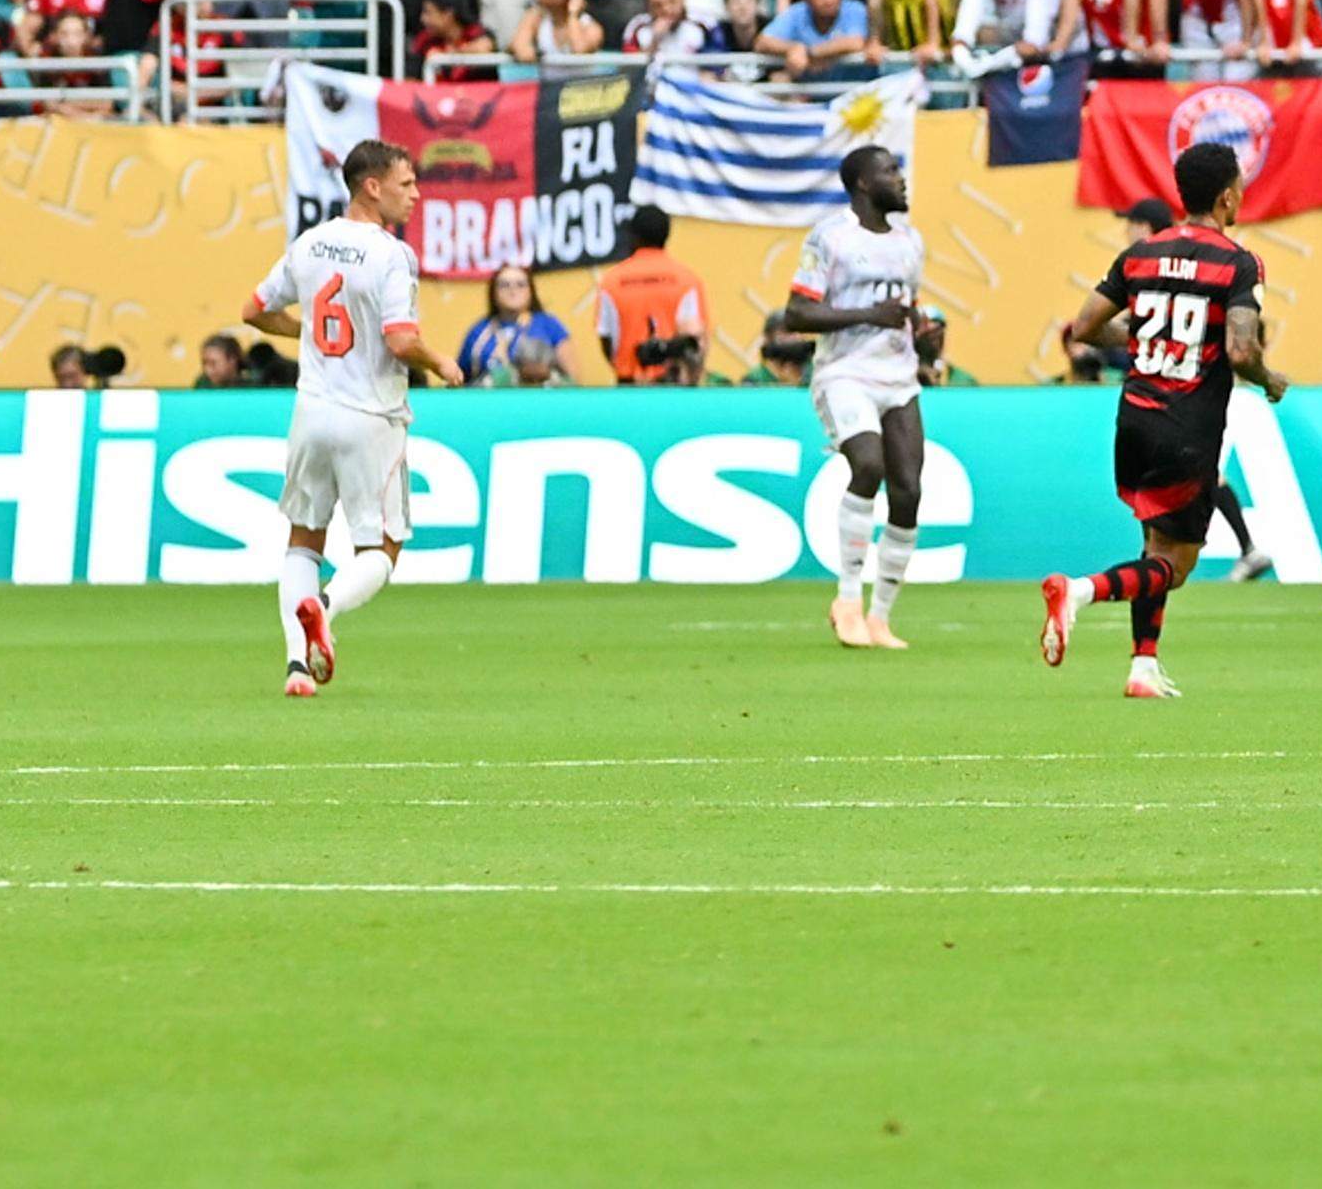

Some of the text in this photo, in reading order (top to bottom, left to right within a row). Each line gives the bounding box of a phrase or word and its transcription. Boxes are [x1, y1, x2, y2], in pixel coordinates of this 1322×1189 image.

[561, 120, 617, 184] FLA
[422, 182, 617, 273] BRANCO
[312, 271, 355, 358] 6
[1134, 289, 1211, 382] 29
